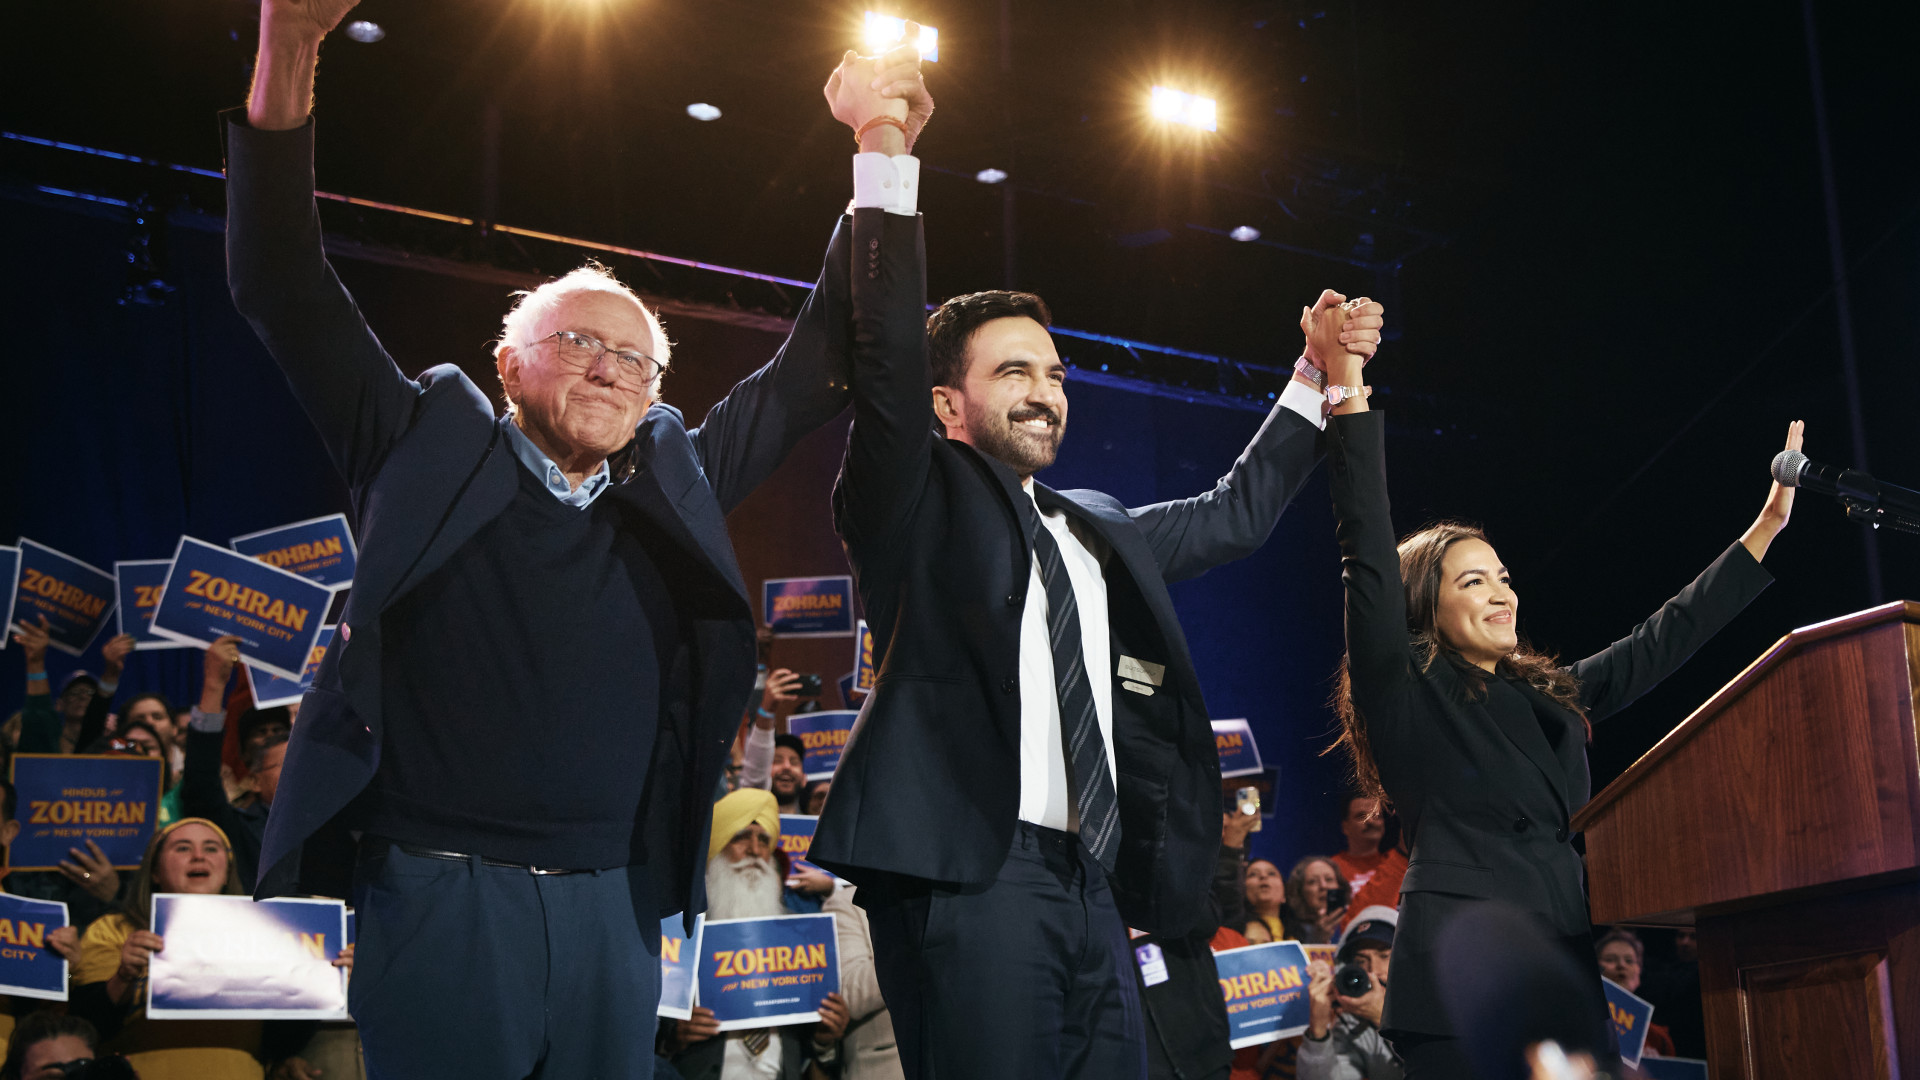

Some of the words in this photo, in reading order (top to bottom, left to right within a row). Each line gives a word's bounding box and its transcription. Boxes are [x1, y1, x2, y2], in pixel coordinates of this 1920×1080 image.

[20, 567, 107, 619] ZOHRAN
[183, 569, 309, 631] ZOHRAN
[773, 594, 842, 612] ZOHRAN
[204, 604, 234, 620] NEW
[235, 612, 268, 633] YORK
[267, 626, 295, 643] CITY
[62, 787, 107, 798] HINDUS
[28, 800, 147, 824] ZOHRAN
[53, 828, 83, 837] NEW
[85, 828, 115, 837] YORK
[118, 828, 140, 837] CITY
[1, 948, 37, 961] CITY
[713, 943, 828, 978] ZOHRAN
[740, 979, 770, 990] NEW
[771, 975, 799, 987] YORK
[800, 973, 825, 985] CITY
[1249, 996, 1278, 1009] YORK
[1279, 991, 1302, 1003] CITY
